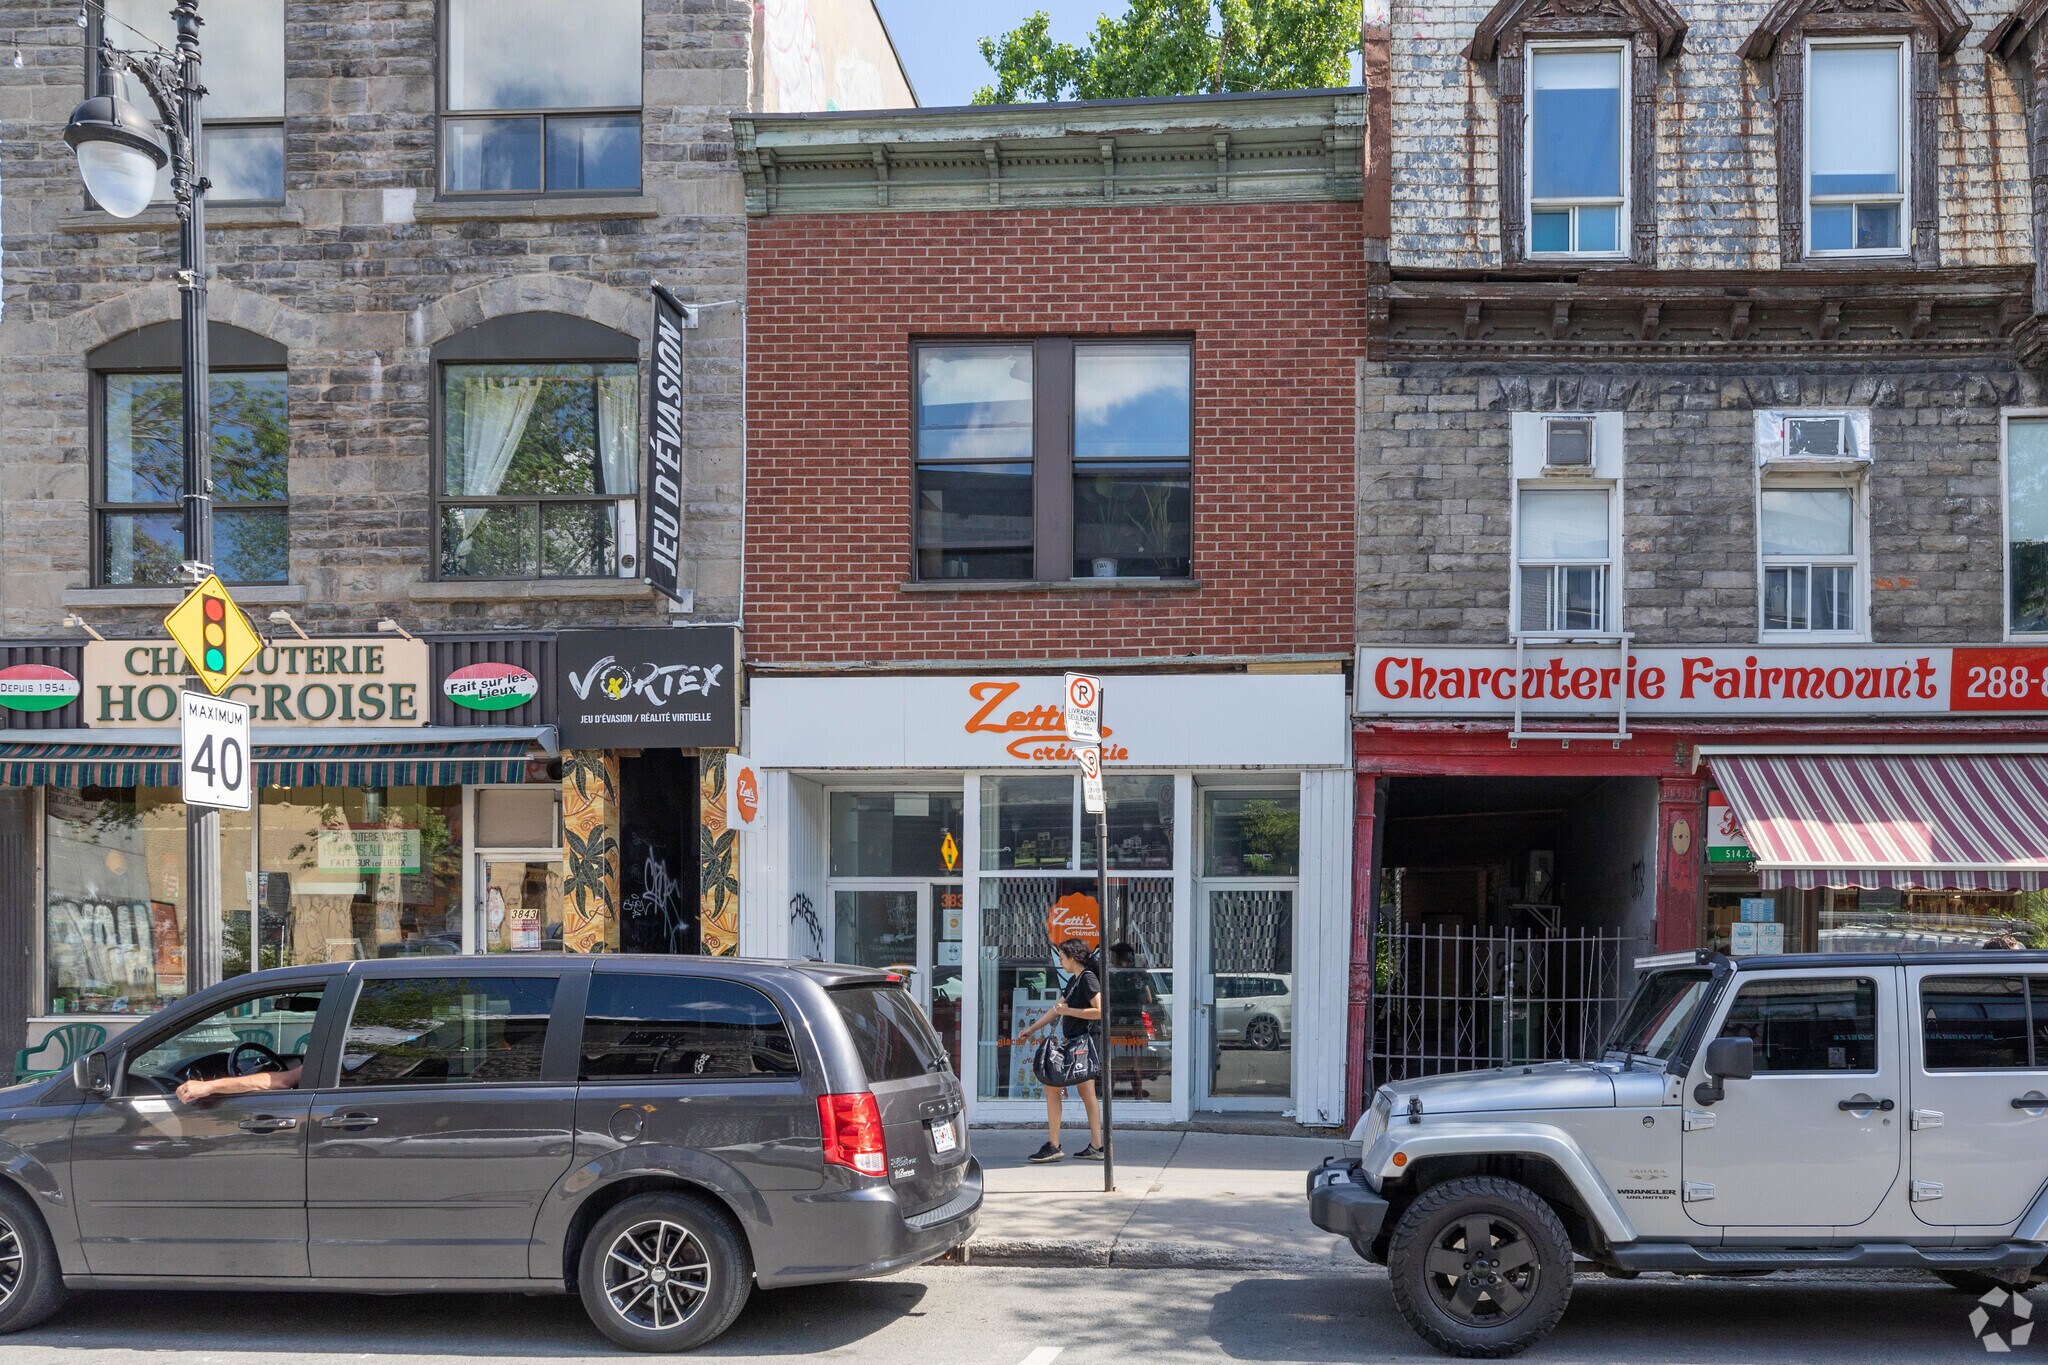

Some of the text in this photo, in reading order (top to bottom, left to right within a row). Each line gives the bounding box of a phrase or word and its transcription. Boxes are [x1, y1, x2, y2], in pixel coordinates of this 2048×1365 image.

[650, 313, 682, 577] JEU D'ÉVASION
[124, 646, 385, 676] CHUTERIE
[450, 673, 528, 694] Fait sur les
[568, 655, 724, 707] VORTEX
[1374, 655, 1666, 700] Charcuterie
[1679, 655, 1938, 700] Fairmount
[39, 683, 65, 693] 1954
[478, 685, 517, 699] Lieux
[97, 683, 418, 722] HOGROISE
[1067, 707, 1097, 717] LIVRAISON
[189, 703, 243, 726] MAXIMUM
[580, 714, 594, 724] JEU
[594, 713, 633, 723] D'ÉVASION
[640, 711, 671, 722] RÉALITÉ
[671, 712, 712, 722] VIRTUELLE
[1067, 714, 1097, 724] SEULEMENT
[191, 733, 243, 792] 40
[330, 859, 351, 867] FAIT
[355, 859, 370, 867] SUR
[511, 909, 537, 919] 3843
[1052, 907, 1097, 927] Zetti's
